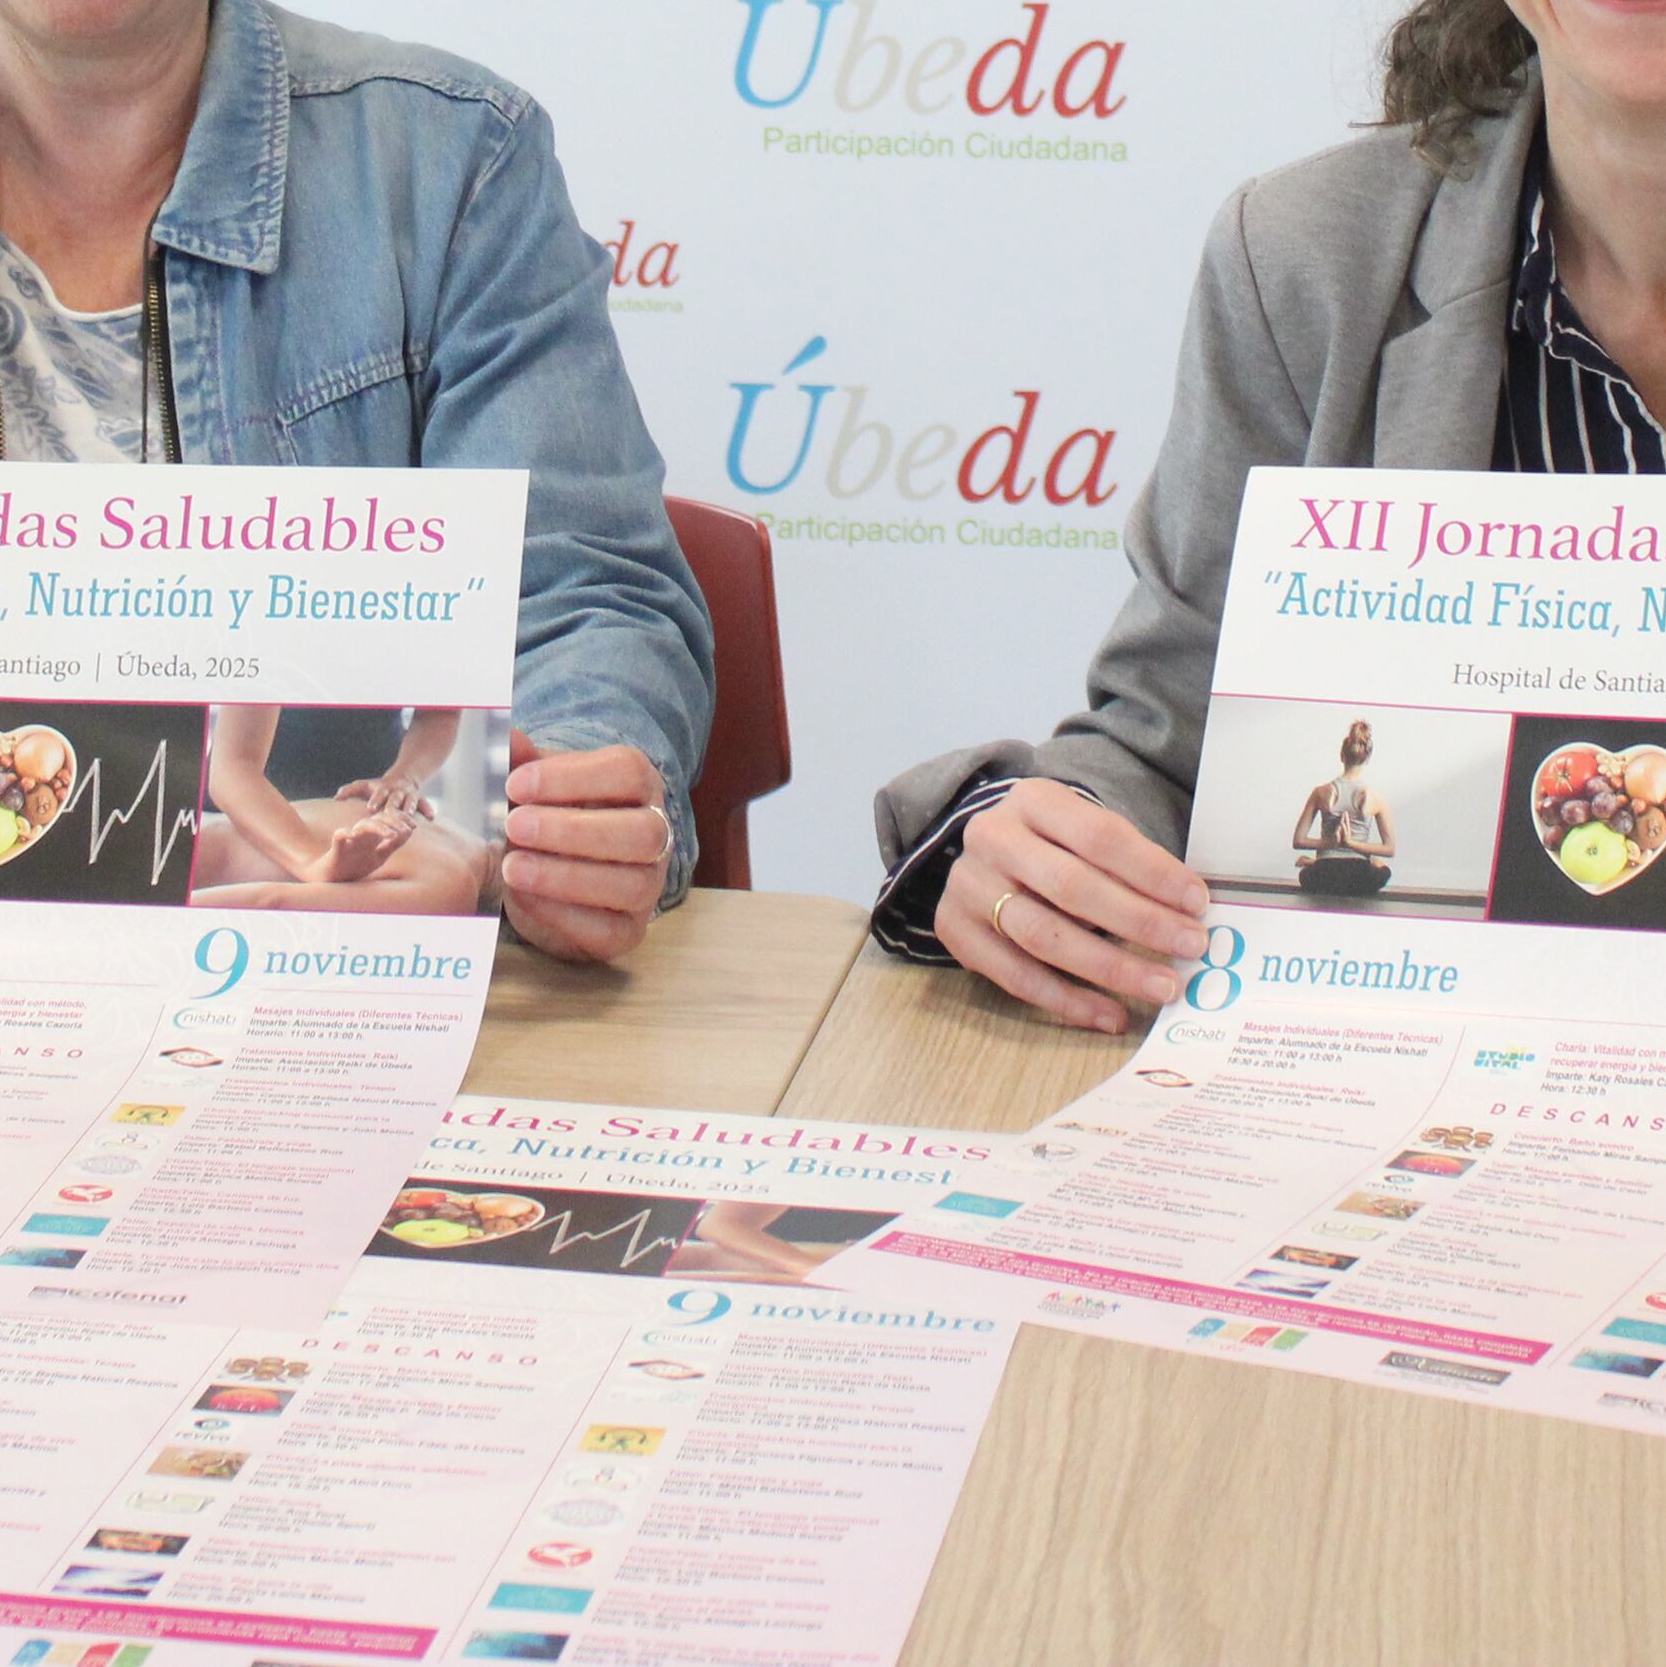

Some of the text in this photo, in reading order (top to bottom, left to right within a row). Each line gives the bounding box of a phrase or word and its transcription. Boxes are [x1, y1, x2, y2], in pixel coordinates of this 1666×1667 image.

[763, 127, 1128, 163] Participación Ciudadana
[725, 335, 1117, 507] Úbeda
[100, 494, 445, 554] Saludables
[755, 513, 1119, 550] Participación Ciudadana
[1291, 497, 1395, 552] XII
[25, 572, 213, 618] Nutrición
[229, 590, 253, 630] y
[1487, 582, 1620, 638] Física,
[117, 651, 197, 680] Úbeda,
[205, 657, 259, 678] 2025
[1453, 664, 1551, 694] Hospital
[1559, 668, 1586, 690] de
[191, 928, 472, 999] 9 noviembre
[1184, 925, 1458, 1012] 8 noviembre
[1594, 1044, 1635, 1057] Vitalidad
[1638, 1048, 1657, 1058] con
[1639, 1063, 1646, 1073] y
[1588, 1072, 1611, 1085] Katy
[1614, 1074, 1653, 1087] Rosales
[508, 1136, 724, 1170] Nutrición
[741, 1159, 769, 1175] y
[599, 1114, 992, 1162] Saludables
[451, 1161, 564, 1180] Santiago
[664, 1287, 997, 1335] 9 noviembre
